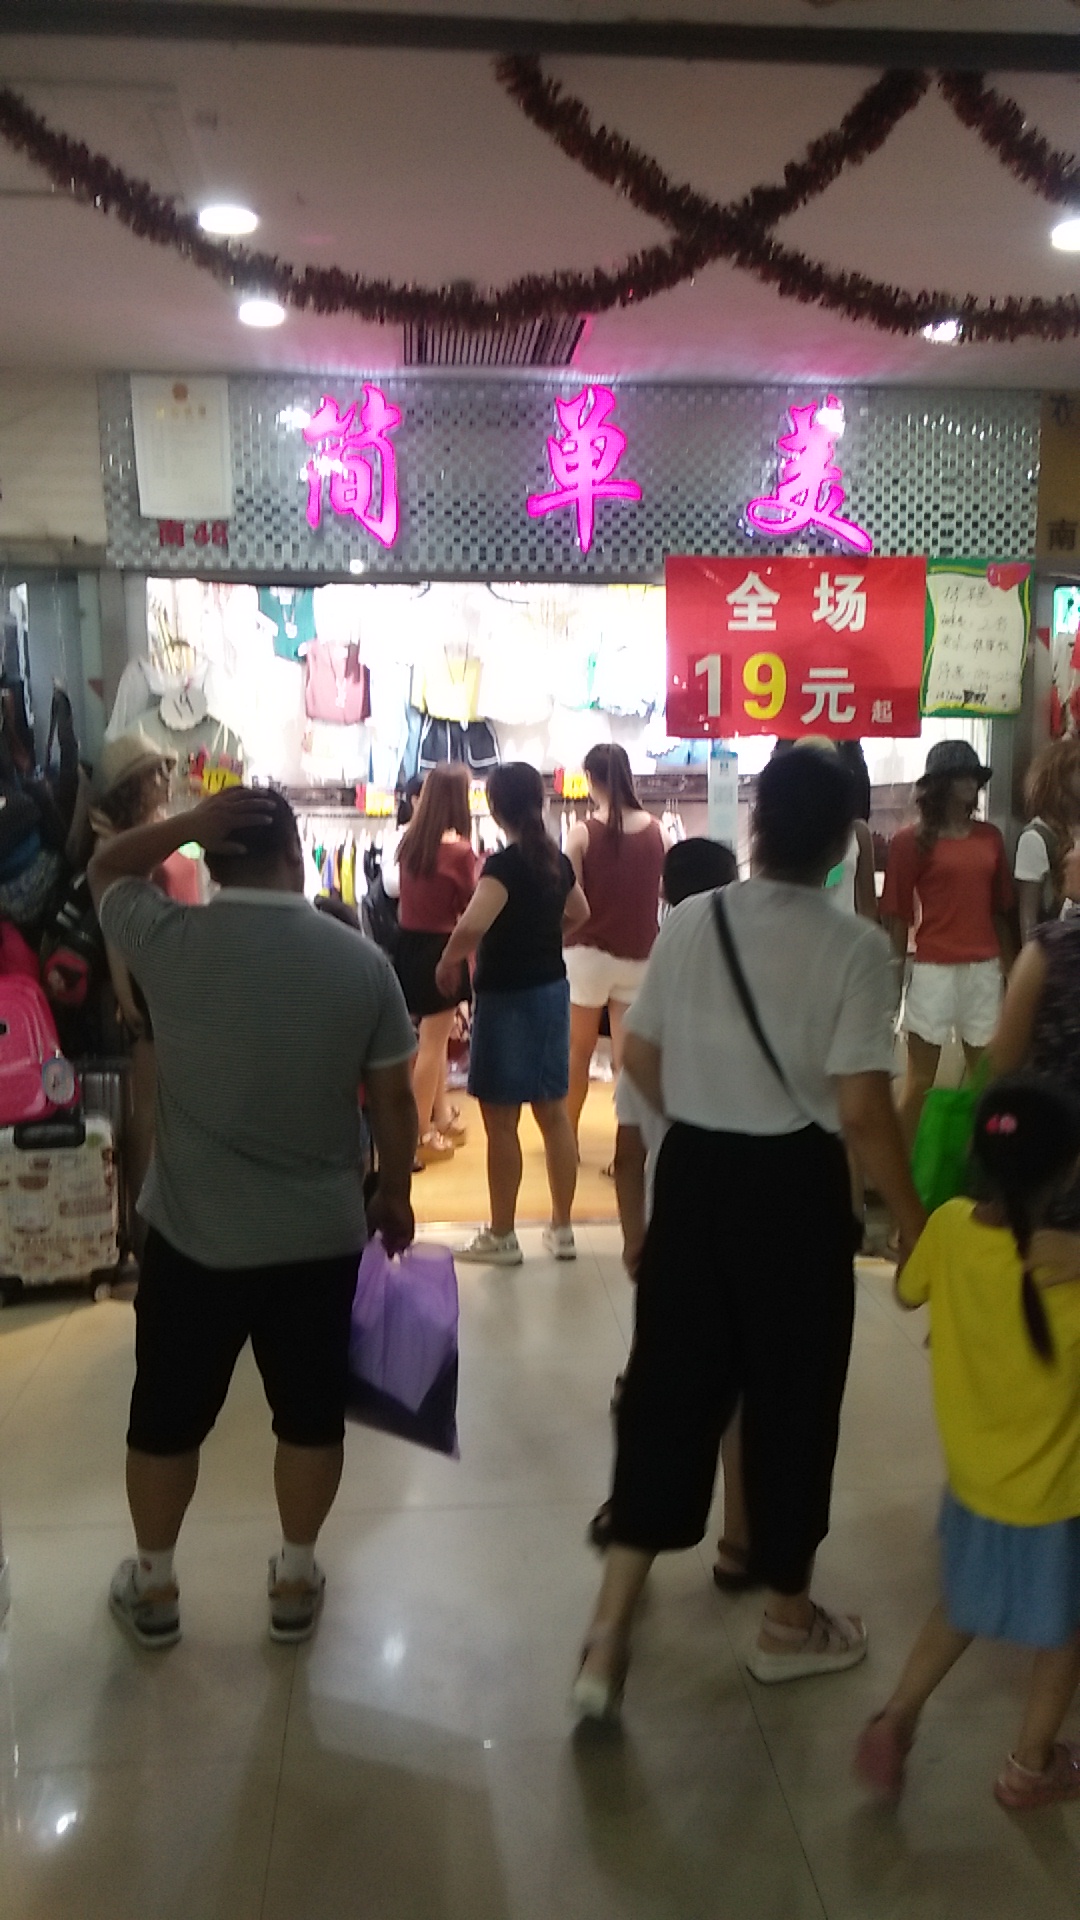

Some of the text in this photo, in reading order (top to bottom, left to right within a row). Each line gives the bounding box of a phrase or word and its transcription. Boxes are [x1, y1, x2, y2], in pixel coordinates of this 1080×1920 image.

[303, 383, 872, 553] 简单美
[725, 570, 867, 633] 全场
[694, 651, 893, 726] 19元起
